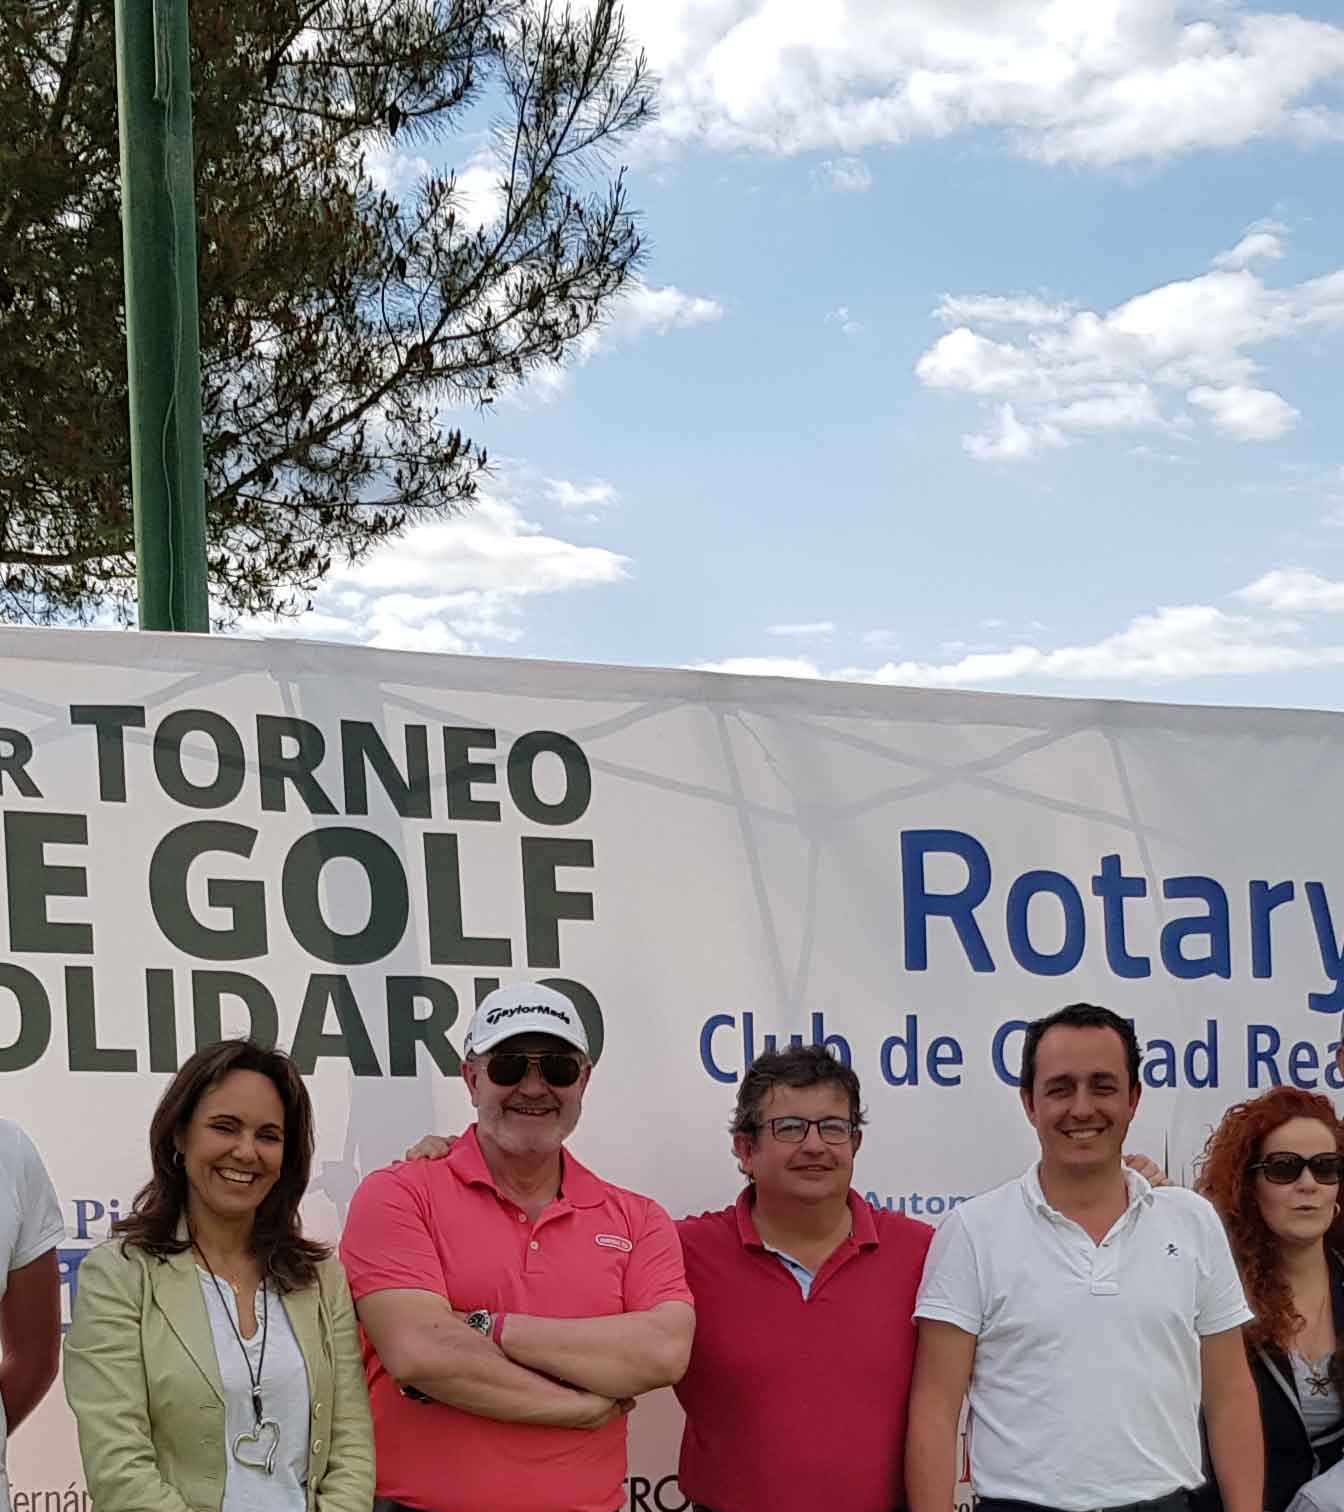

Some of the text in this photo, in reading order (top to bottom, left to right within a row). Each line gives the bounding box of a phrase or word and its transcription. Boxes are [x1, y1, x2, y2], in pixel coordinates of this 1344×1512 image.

[70, 704, 592, 826] TORNEO
[148, 820, 595, 969] GOLF
[880, 1014, 964, 1087] de
[72, 1198, 121, 1240] Pi
